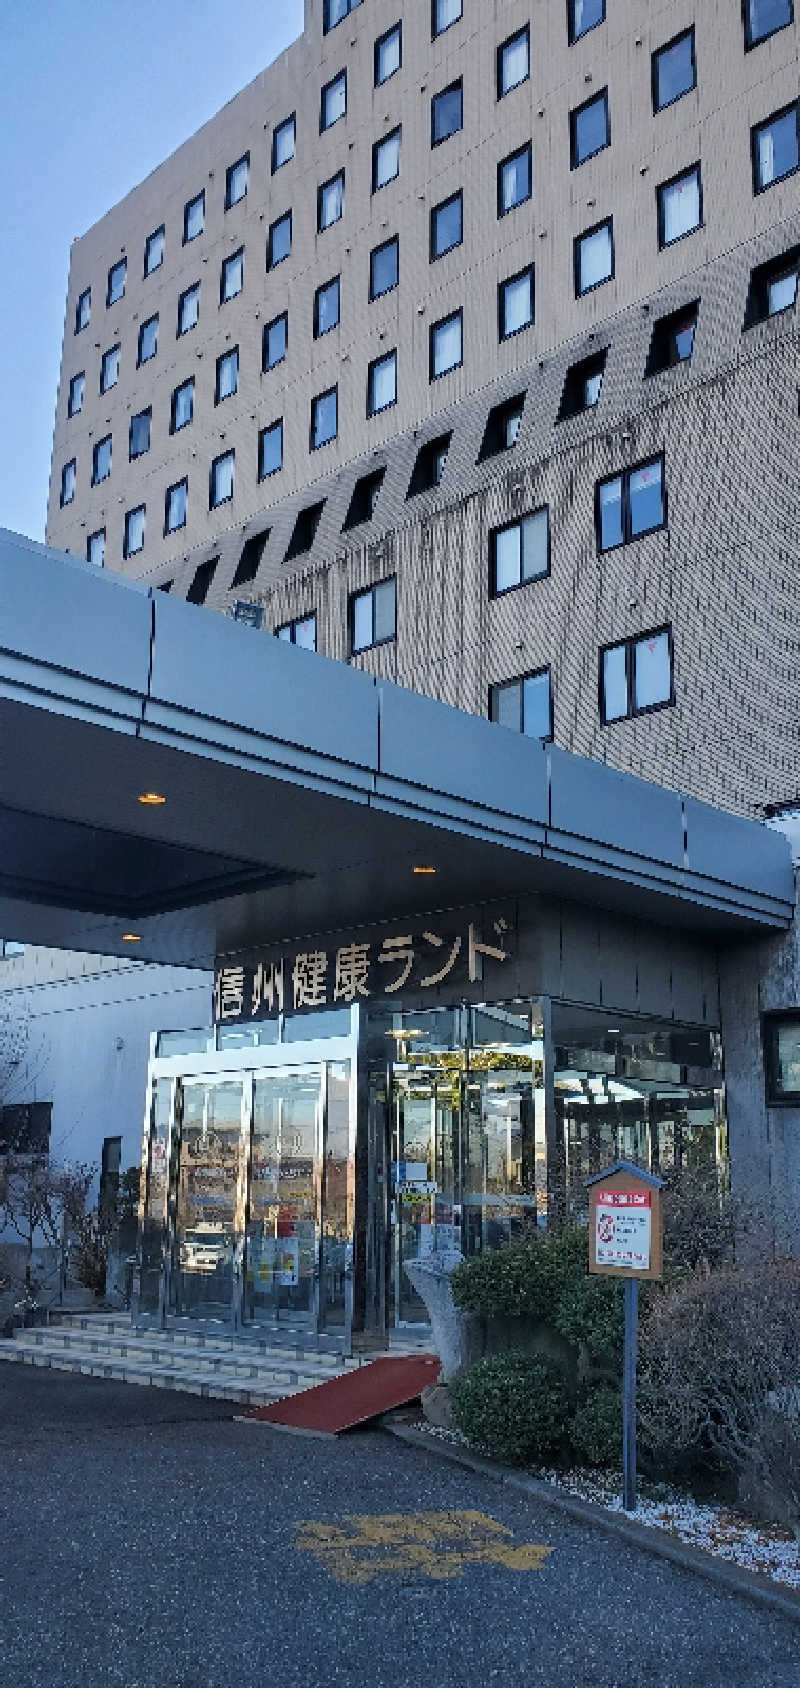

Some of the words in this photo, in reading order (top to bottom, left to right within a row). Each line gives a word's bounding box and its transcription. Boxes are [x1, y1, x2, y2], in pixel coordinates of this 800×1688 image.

[213, 918, 512, 1020] 信州健康ランド
